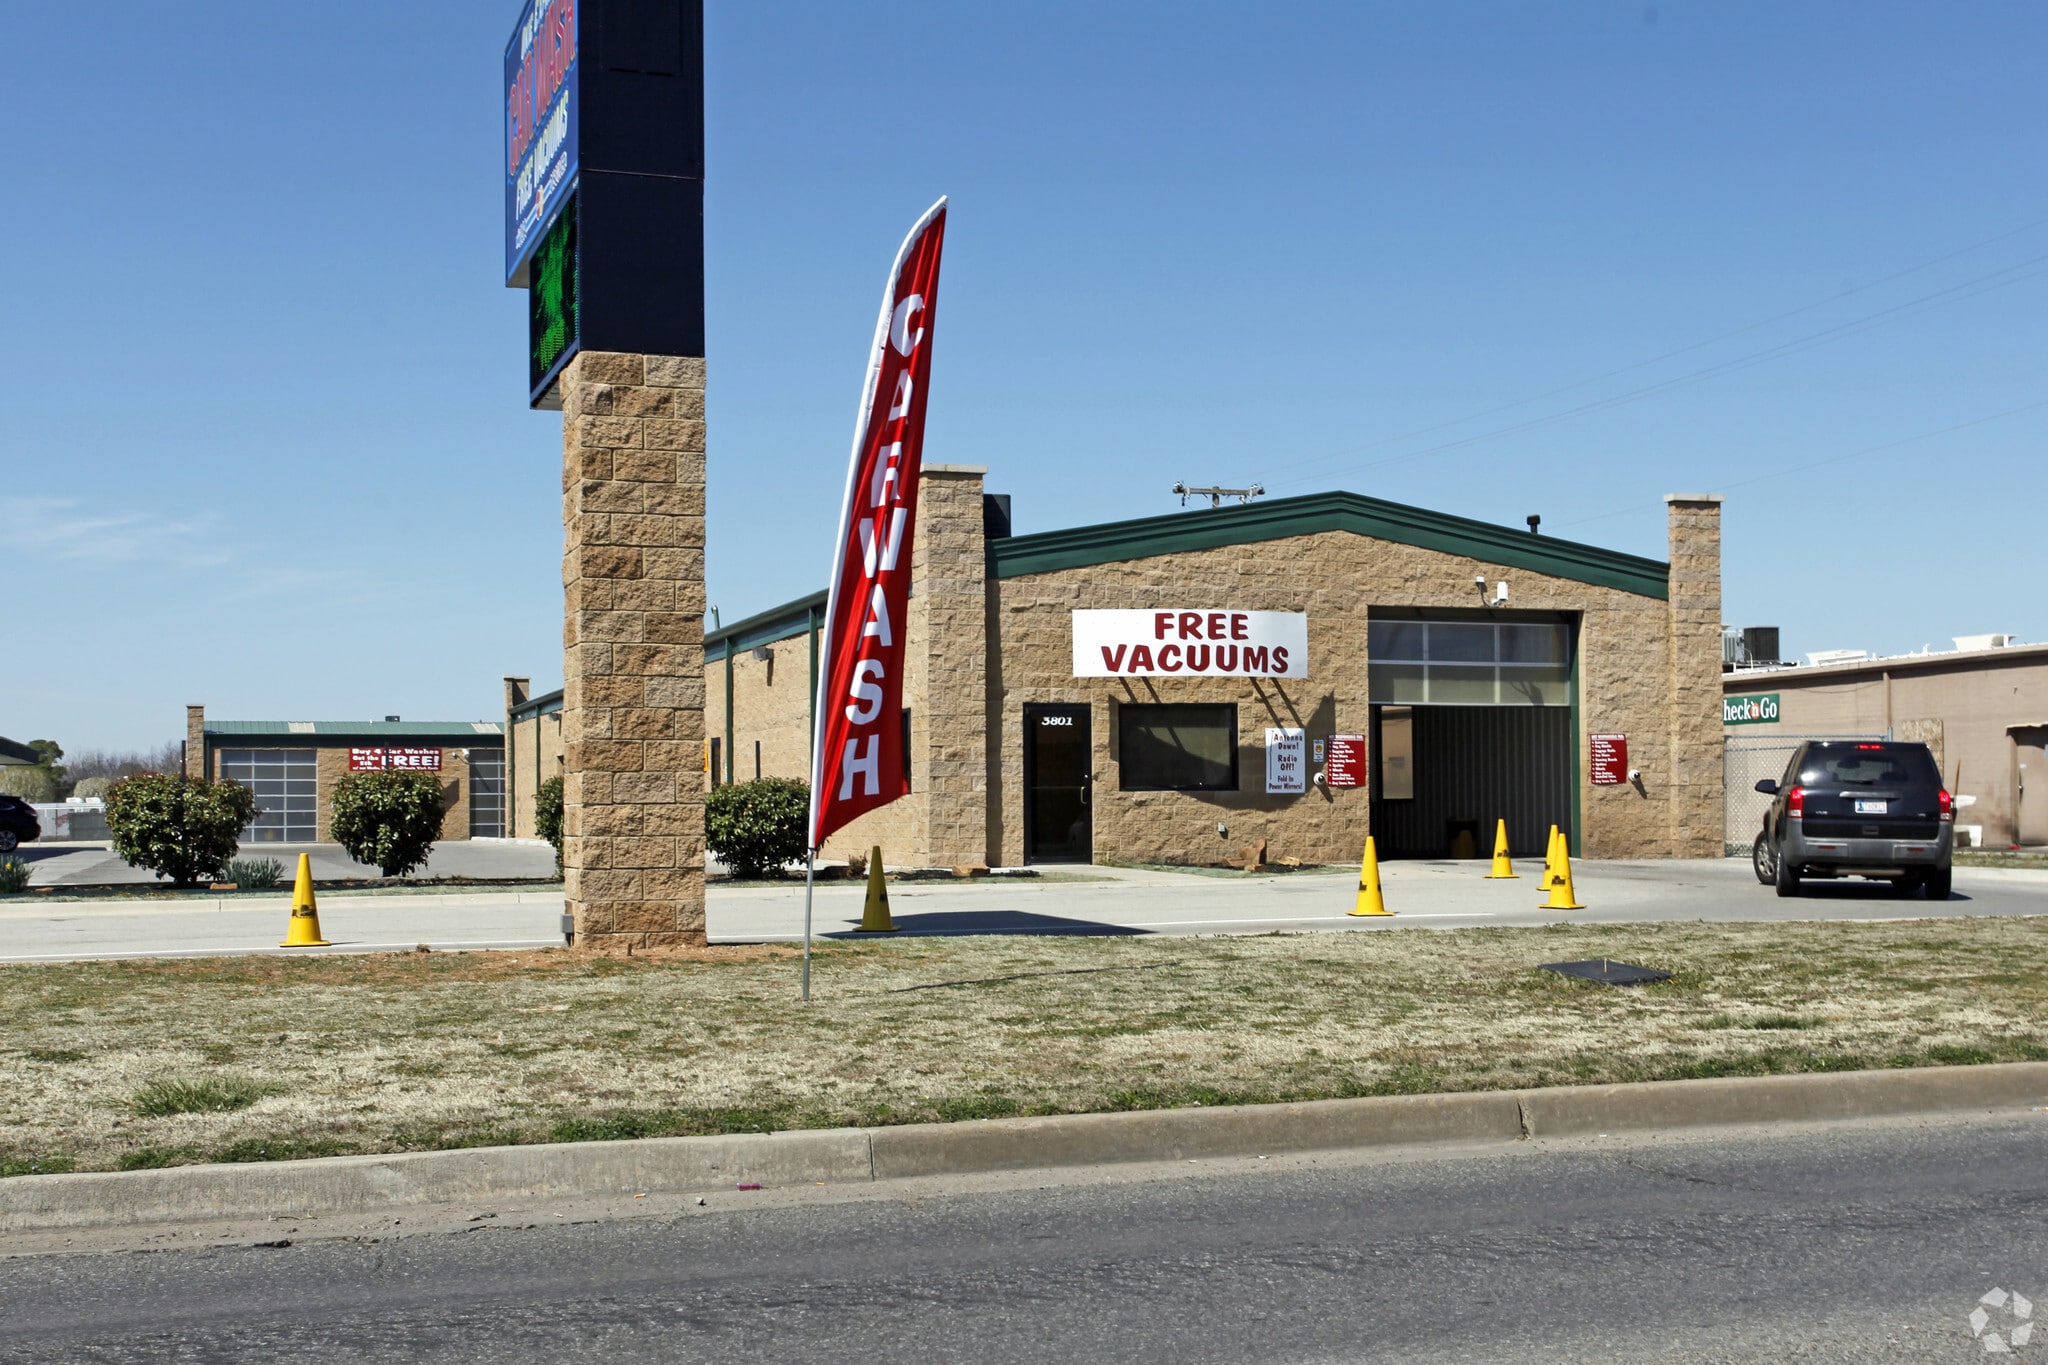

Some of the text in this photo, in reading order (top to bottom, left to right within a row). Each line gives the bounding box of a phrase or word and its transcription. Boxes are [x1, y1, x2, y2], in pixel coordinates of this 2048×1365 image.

[509, 50, 534, 177] CAR
[1154, 612, 1249, 641] FREE
[1100, 644, 1289, 674] VACUUMS
[1723, 698, 1751, 721] heck
[1760, 697, 1777, 718] Go
[1278, 742, 1299, 750] Down!
[381, 755, 440, 766] FREE!
[1278, 754, 1297, 762] Radio
[1280, 763, 1295, 771] Off!
